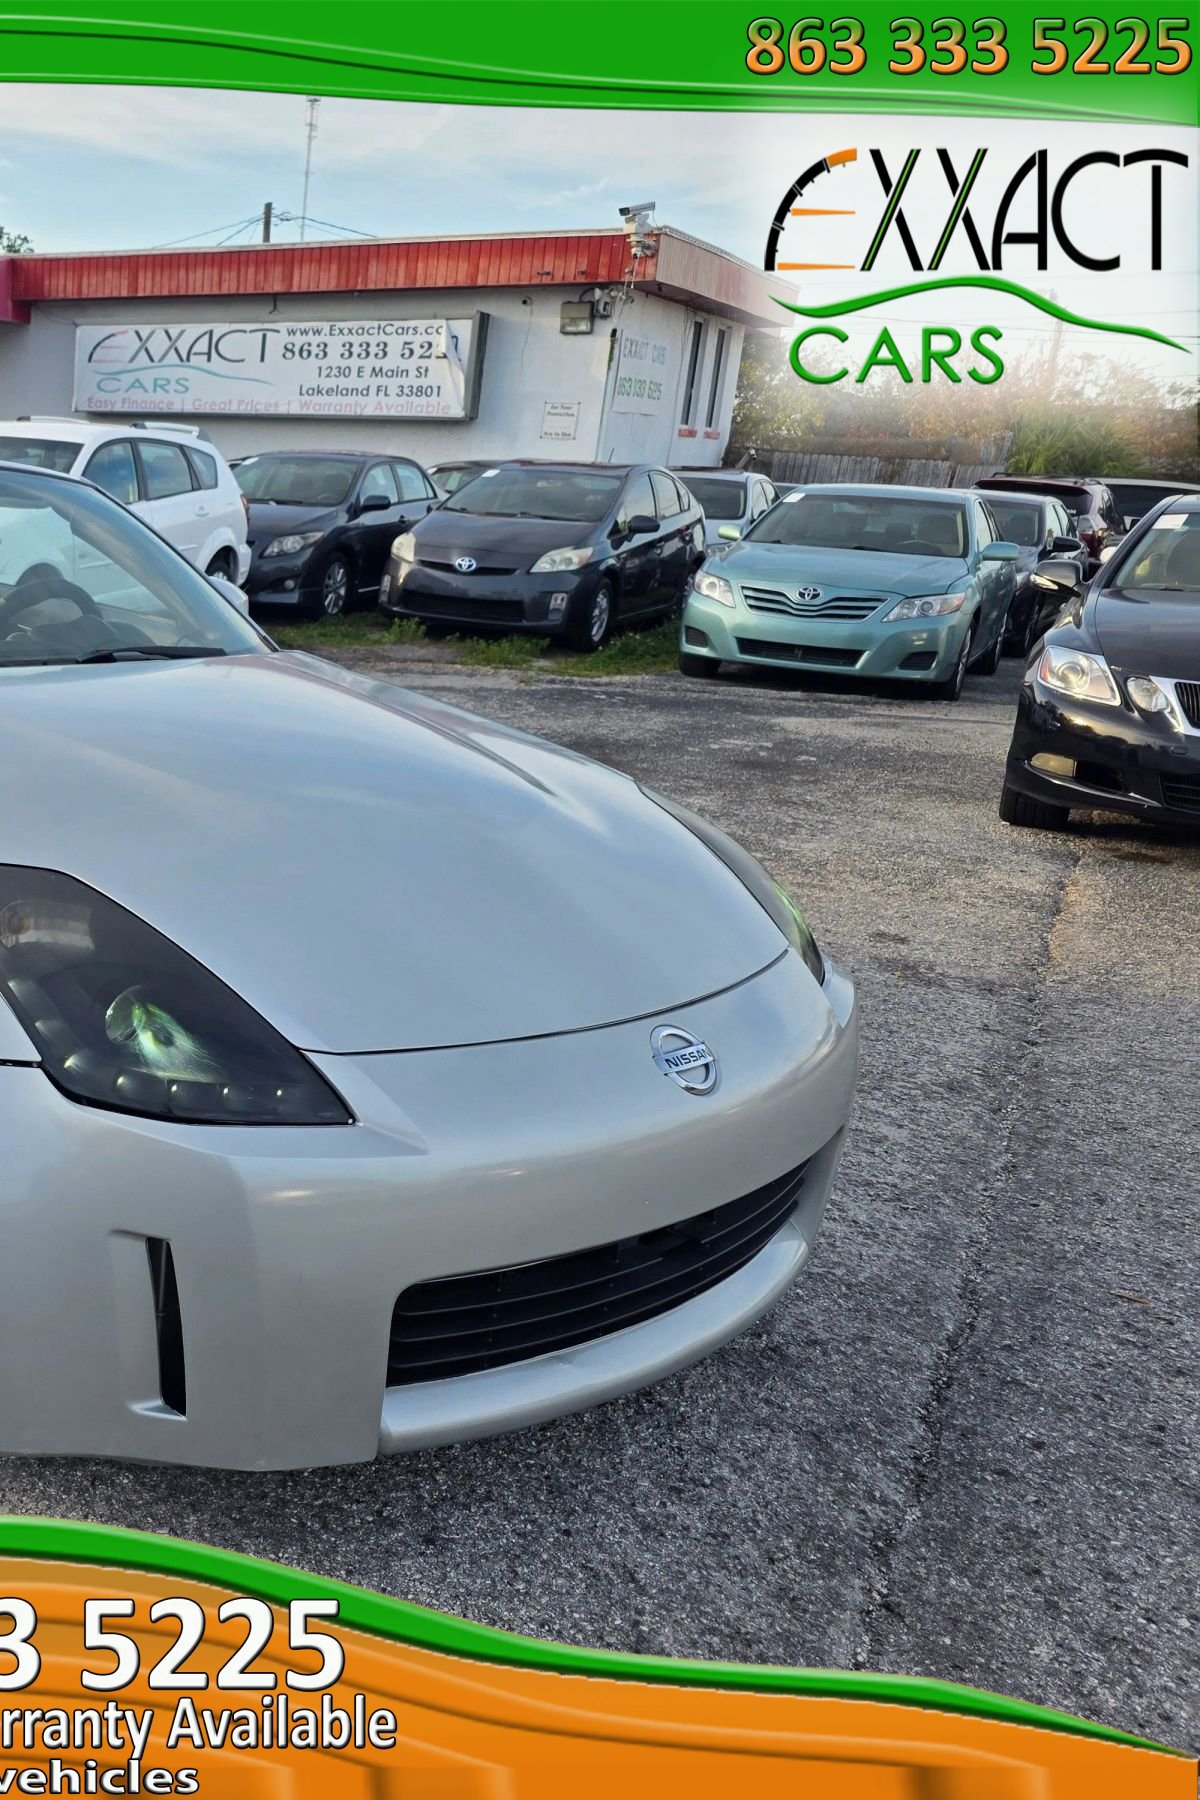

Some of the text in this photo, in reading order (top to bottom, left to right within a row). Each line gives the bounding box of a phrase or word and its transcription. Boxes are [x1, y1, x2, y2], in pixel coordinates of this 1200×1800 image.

[88, 328, 280, 363] EXXACT
[282, 341, 328, 360] 863
[339, 341, 388, 360] 333
[317, 366, 430, 379] 1230 E Main St
[96, 377, 189, 394] CARS
[299, 384, 441, 398] Lakeland FL 33801
[87, 397, 451, 415] Easy Finance Great Prices Warranty Available
[664, 1047, 712, 1069] NISSAN
